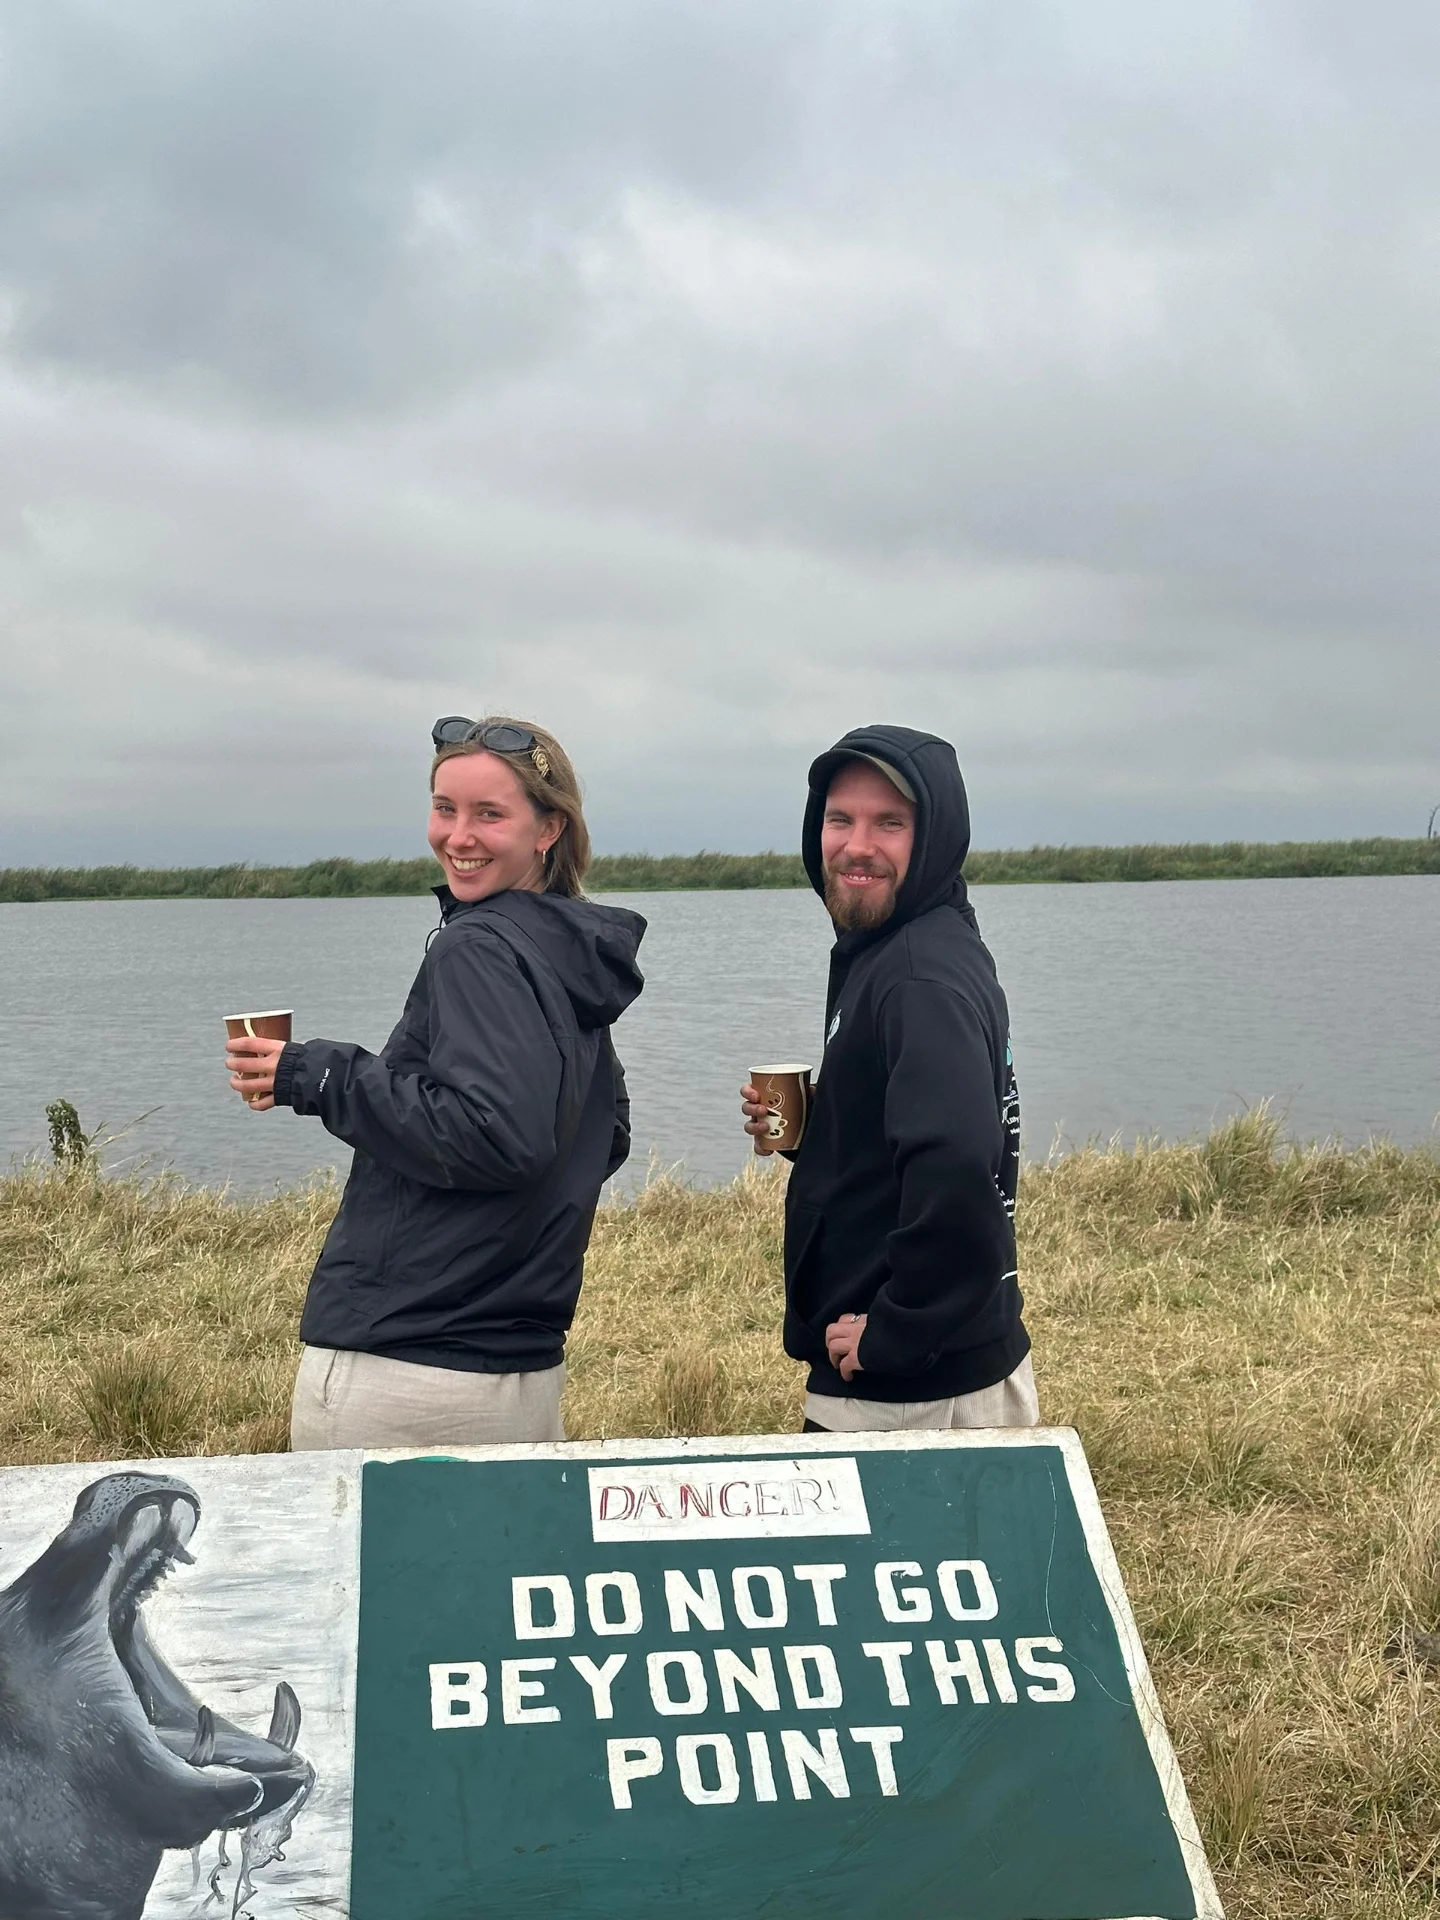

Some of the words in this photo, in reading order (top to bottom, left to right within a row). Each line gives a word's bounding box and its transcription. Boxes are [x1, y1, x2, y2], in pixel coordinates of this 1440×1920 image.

[598, 1477, 842, 1521] DANGER!
[512, 1570, 644, 1641] DO
[664, 1563, 847, 1633] NOT
[875, 1559, 999, 1623] GO
[429, 1644, 843, 1731] BEYOND
[862, 1635, 1076, 1707] THIS
[607, 1725, 904, 1810] POINT
